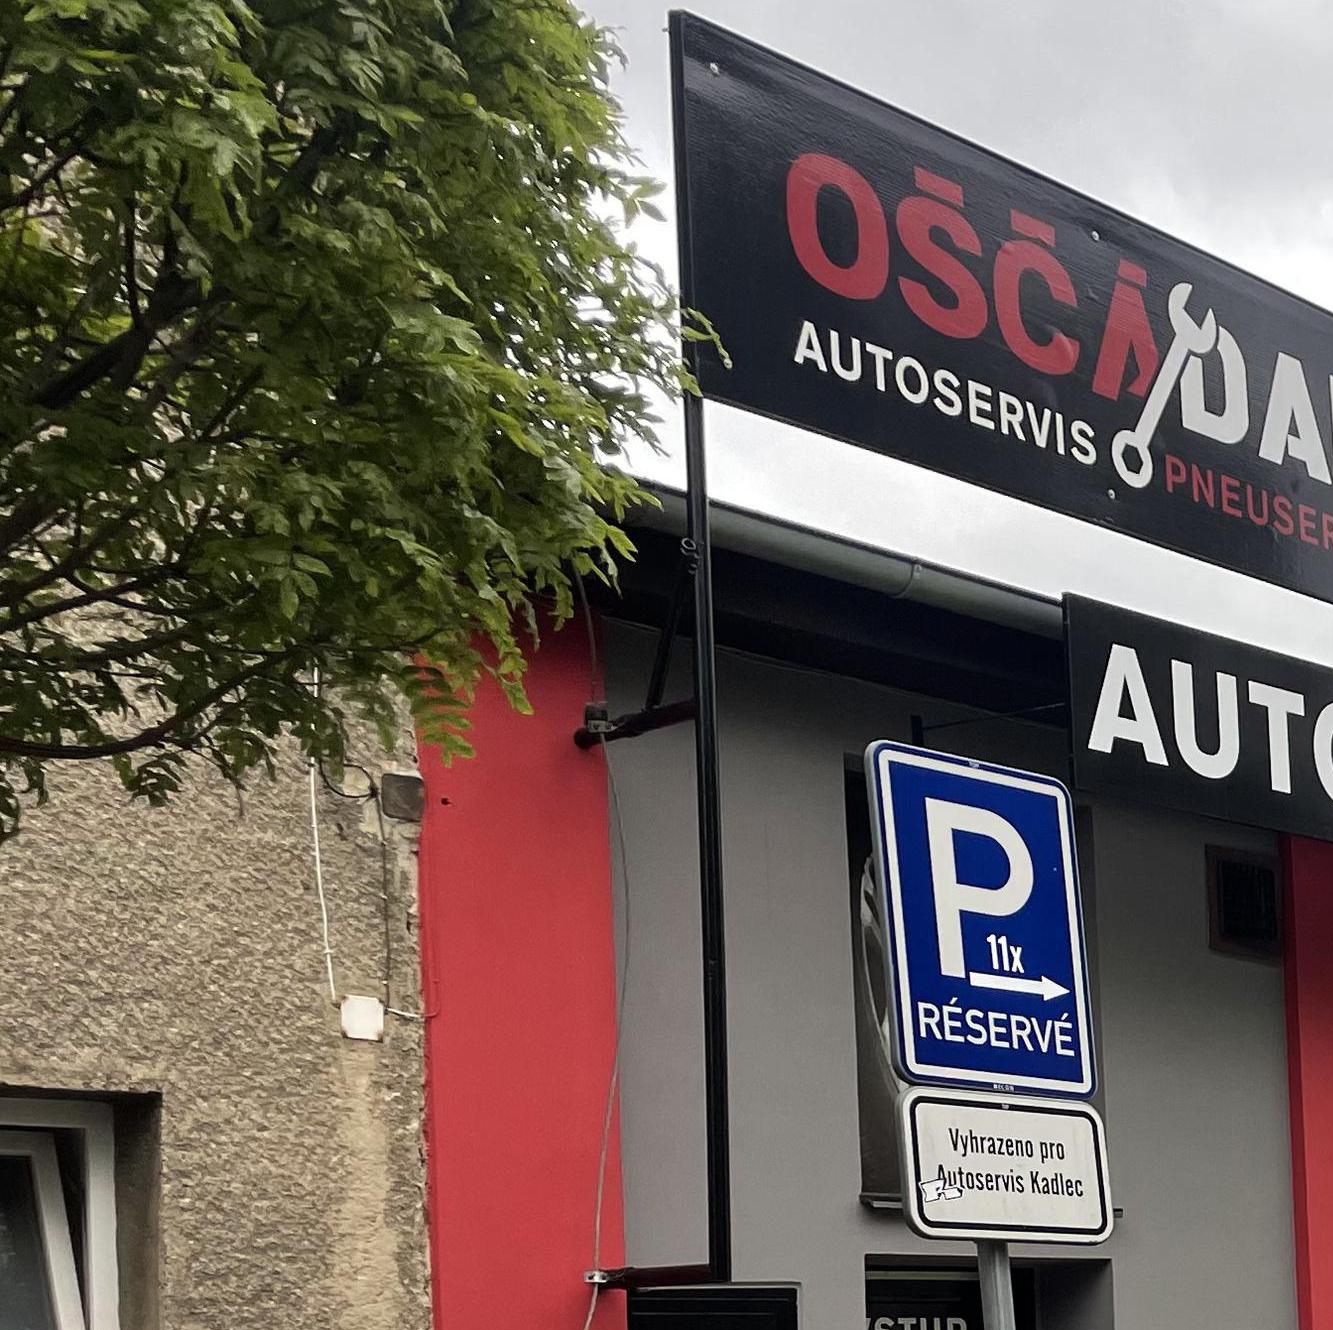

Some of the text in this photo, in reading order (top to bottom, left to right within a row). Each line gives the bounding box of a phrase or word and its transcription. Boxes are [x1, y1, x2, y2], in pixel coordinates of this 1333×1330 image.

[794, 320, 1096, 465] AUTOSERVIS
[925, 797, 1034, 978] P
[986, 934, 1025, 973] 11x
[919, 997, 1075, 1057] RÉSERVÉ
[949, 1128, 1065, 1163] Vyhrazeno pro
[1030, 1170, 1084, 1197] Kadlec
